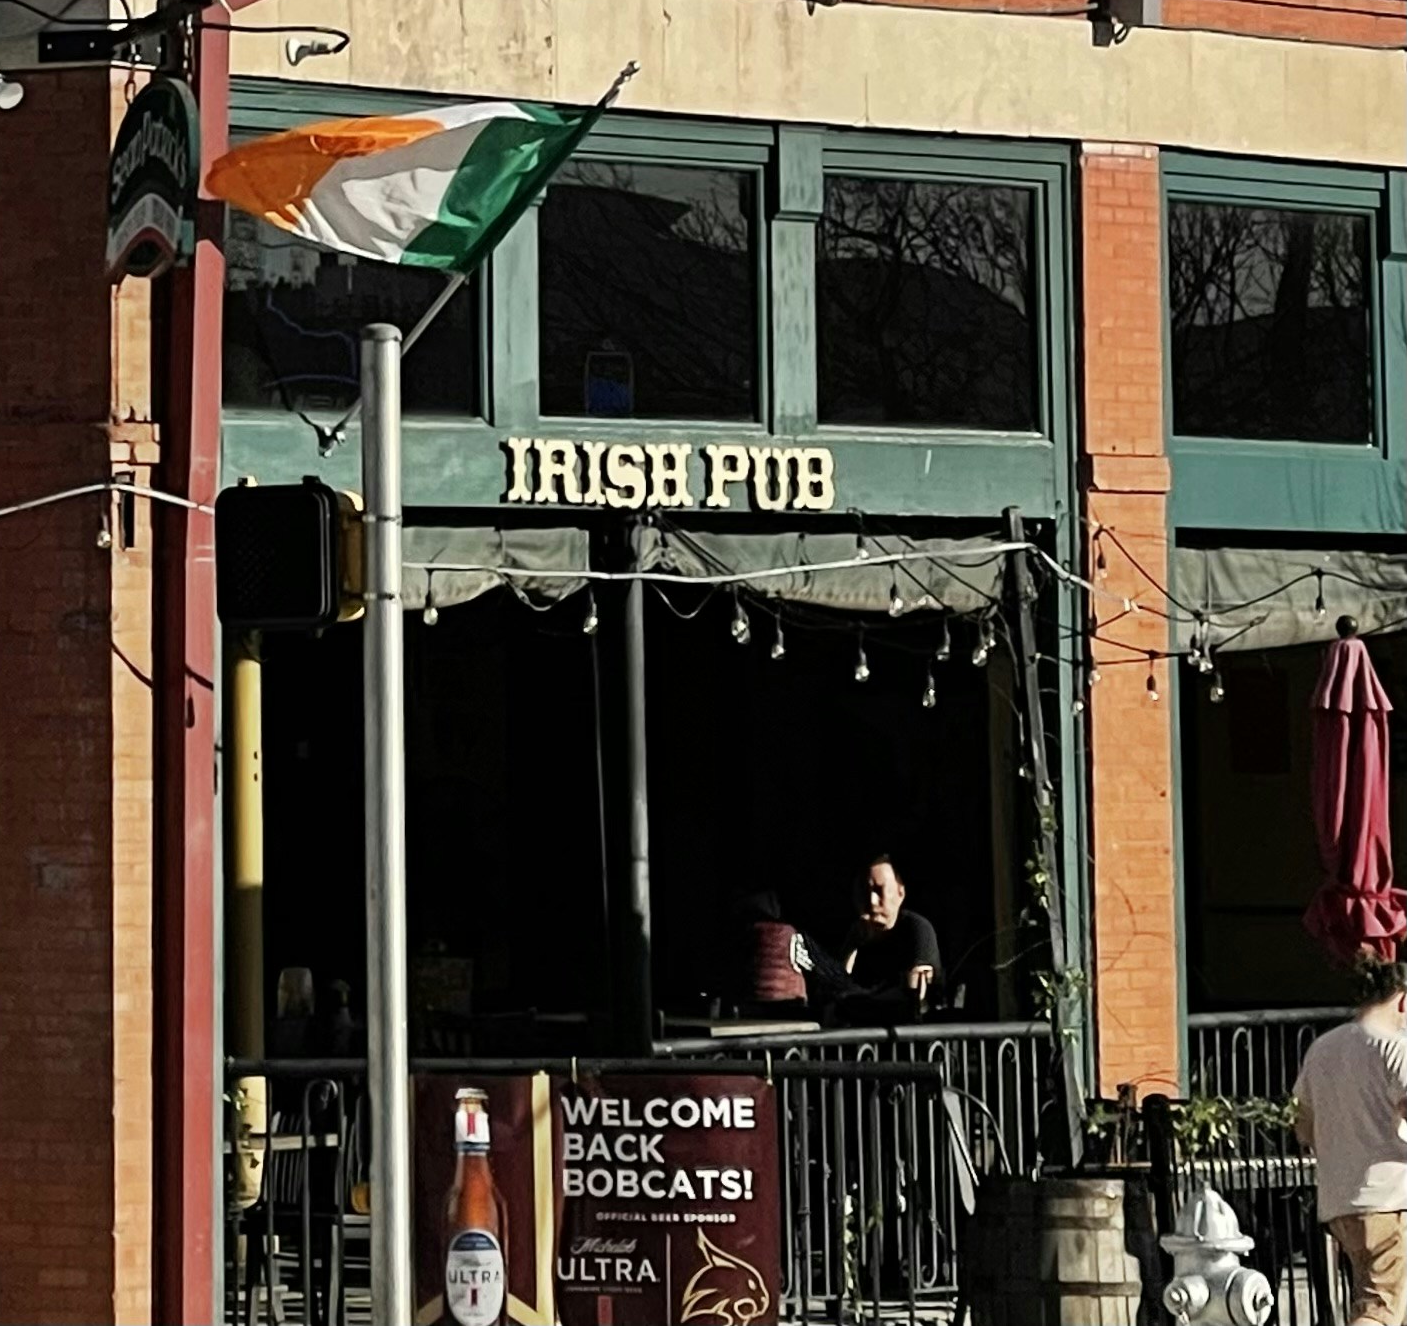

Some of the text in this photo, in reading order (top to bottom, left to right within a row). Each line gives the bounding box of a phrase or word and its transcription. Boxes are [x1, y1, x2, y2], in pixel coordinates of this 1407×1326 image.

[505, 436, 836, 511] IRISH PUB
[560, 1095, 756, 1129] WELCOME
[563, 1132, 665, 1163] BACK
[562, 1168, 754, 1200] BOBCATS!
[595, 1211, 737, 1223] OFFICIAL BEER SPONSOR
[448, 1270, 502, 1284] ULTRA
[557, 1257, 657, 1283] ULTRA
